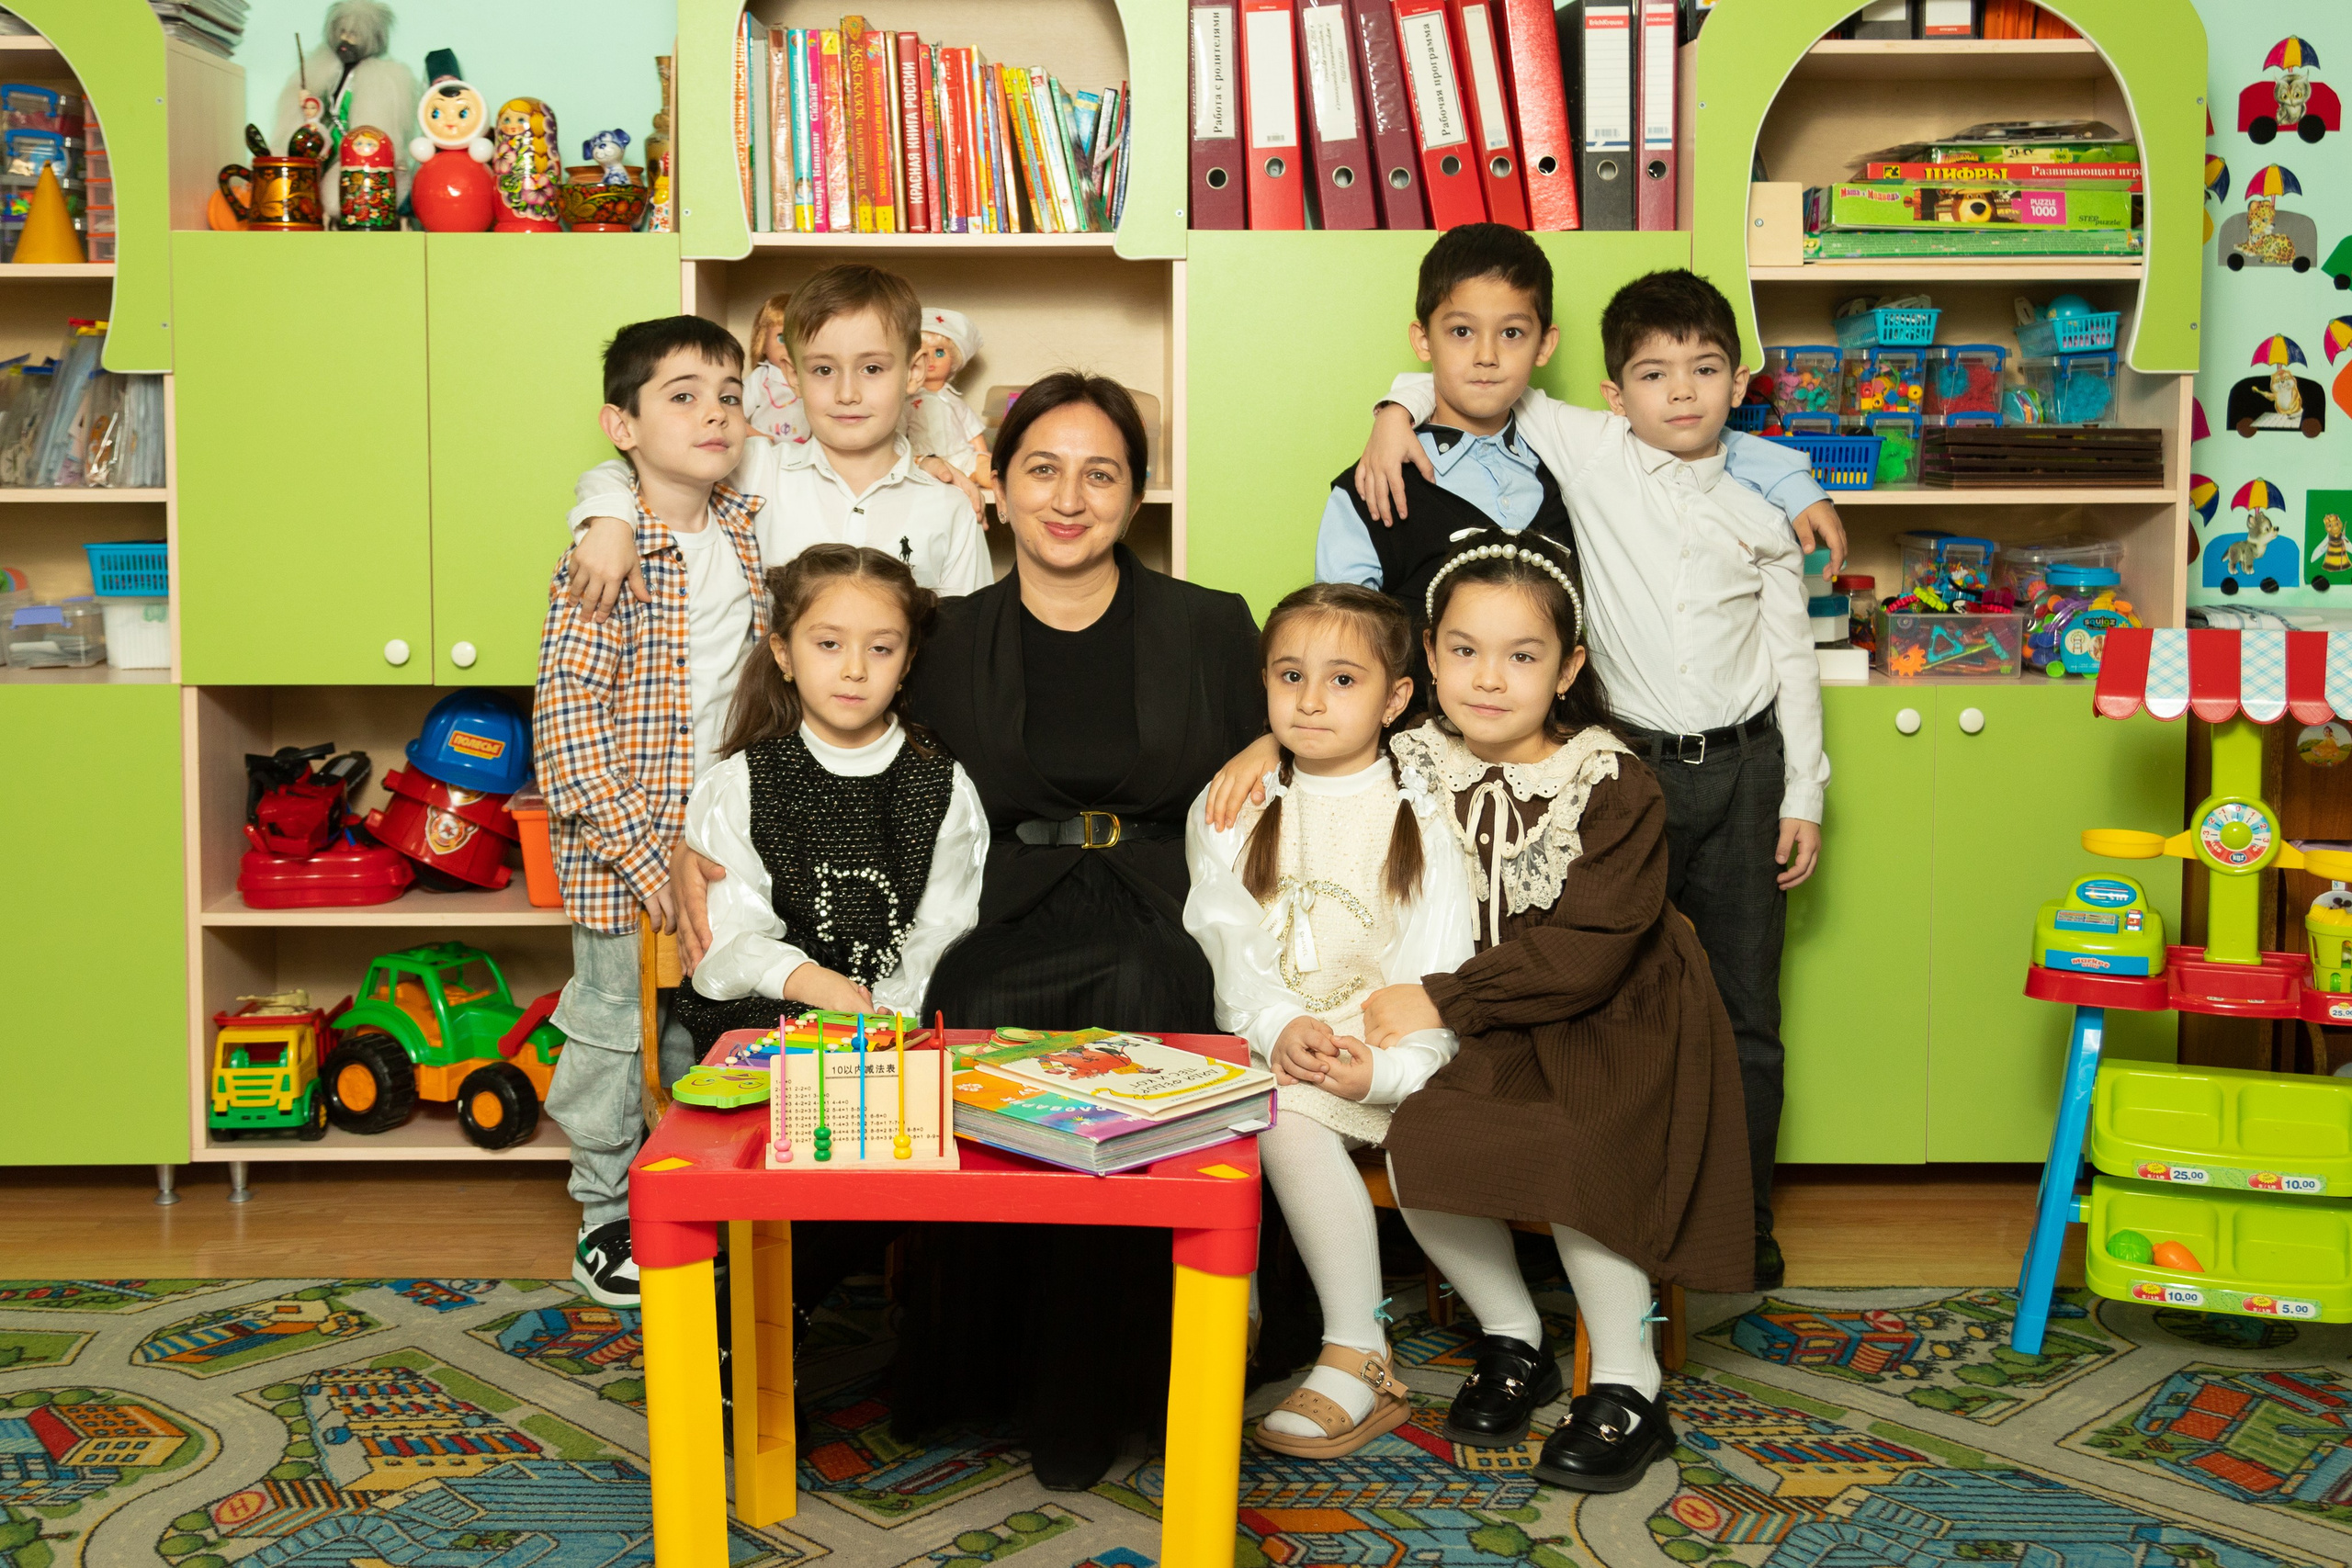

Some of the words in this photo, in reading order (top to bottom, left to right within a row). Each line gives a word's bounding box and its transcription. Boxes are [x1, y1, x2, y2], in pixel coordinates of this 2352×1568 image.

[1213, 12, 1224, 81] родителями
[1423, 23, 1442, 86] программа
[849, 43, 865, 73] 365
[901, 62, 918, 108] РОССИИ
[808, 83, 820, 122] Сказки
[853, 73, 866, 120] СКАЗОК
[1214, 94, 1223, 133] Работа
[1436, 89, 1451, 136] Рабочая
[855, 123, 865, 136] НА
[905, 111, 920, 149] КНИГА
[812, 130, 822, 177] Киплинг
[908, 152, 924, 205] КРАСНАЯ
[1925, 166, 2008, 180] ЦИФРЫ
[2031, 165, 2115, 178] Развивающая
[1839, 186, 1860, 198] Маша
[814, 181, 825, 224] Редьярд
[2030, 198, 2056, 207] PUZZLE
[2030, 206, 2057, 217] 1000
[2078, 214, 2099, 222] STEP
[1128, 1076, 1157, 1088] КОТ
[1183, 1068, 1218, 1081] ДЯДЯ
[1000, 1097, 1107, 1111] СЛОВАРИК
[2173, 1170, 2204, 1180] 25.00
[2285, 1179, 2315, 1190] 10.00
[2167, 1292, 2198, 1302] 10.00
[2282, 1304, 2309, 1314] 5.00
[229, 1497, 250, 1517] H
